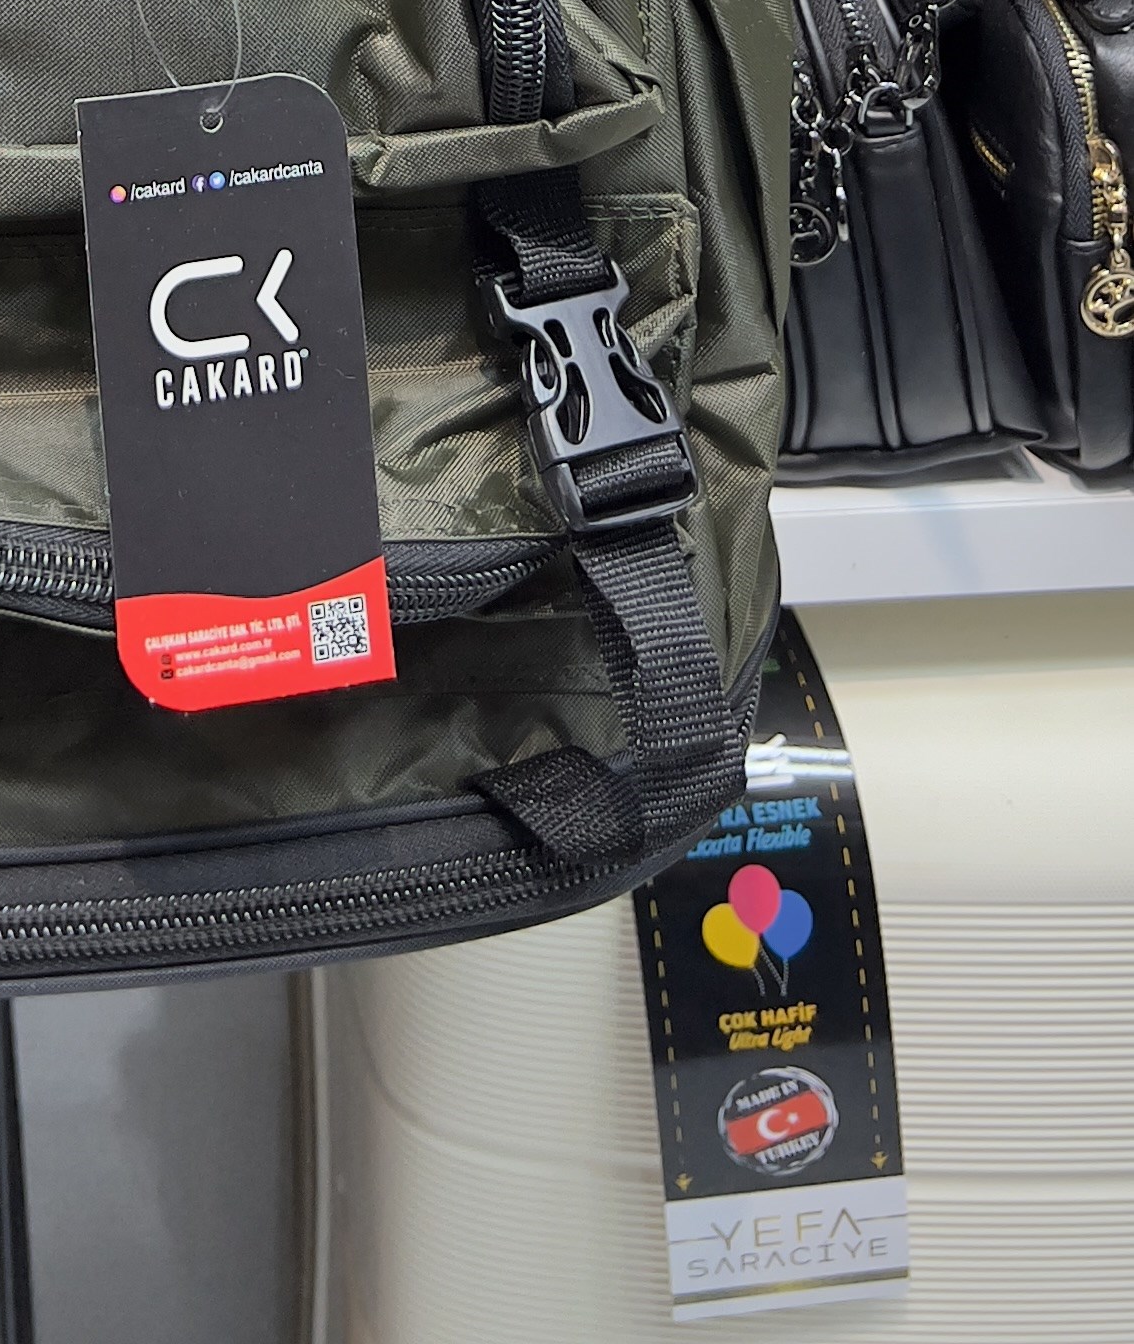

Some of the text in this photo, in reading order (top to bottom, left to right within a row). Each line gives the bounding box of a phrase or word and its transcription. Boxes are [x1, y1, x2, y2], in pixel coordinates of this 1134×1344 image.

[130, 160, 324, 201] /cakard /cakardcanta
[155, 350, 303, 411] CAKARD
[175, 638, 273, 661] www.cakard.com.tr
[751, 796, 823, 824] ESNEK
[746, 822, 812, 852] Flexible
[719, 1001, 818, 1034] ÇOK HAFİF
[729, 1024, 814, 1052] Ultra Light
[710, 1207, 862, 1251] YEFA
